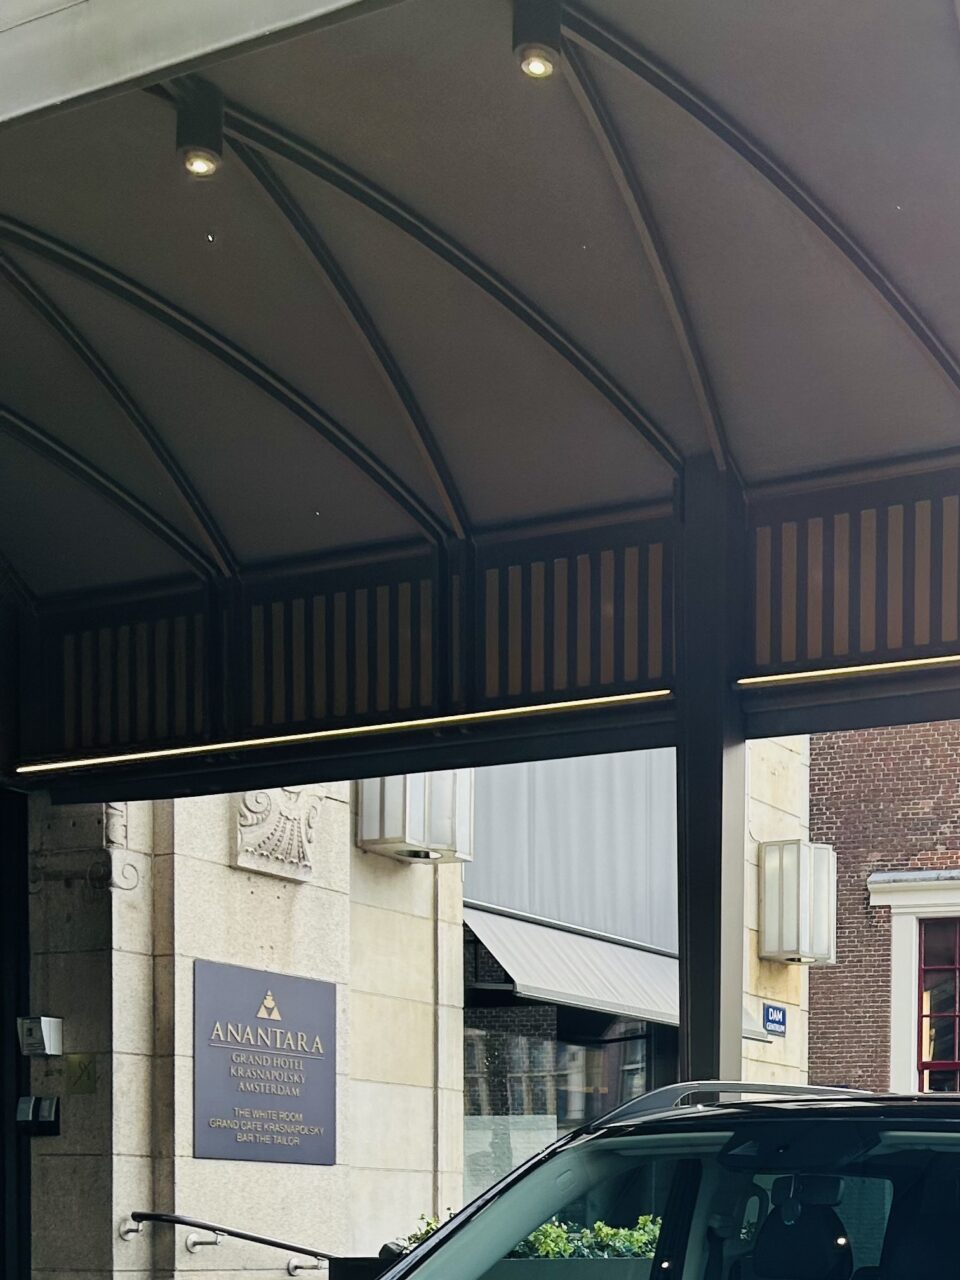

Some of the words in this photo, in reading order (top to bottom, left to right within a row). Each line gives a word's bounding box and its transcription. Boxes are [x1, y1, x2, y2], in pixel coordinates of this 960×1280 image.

[768, 1008, 783, 1022] DAM
[211, 1020, 324, 1054] ANANTARA
[232, 1052, 271, 1066] GRAND
[273, 1057, 304, 1070] HOTEL
[230, 1065, 305, 1084] KRASNAPOLSKY
[238, 1081, 300, 1097] AMSTERDAM
[234, 1107, 251, 1118] THE
[252, 1109, 278, 1120] WHITE
[279, 1112, 303, 1122] ROOM
[209, 1118, 239, 1129] GRAND
[237, 1133, 254, 1142] BAR
[256, 1134, 271, 1144] THE
[273, 1136, 300, 1146] TAILOR
